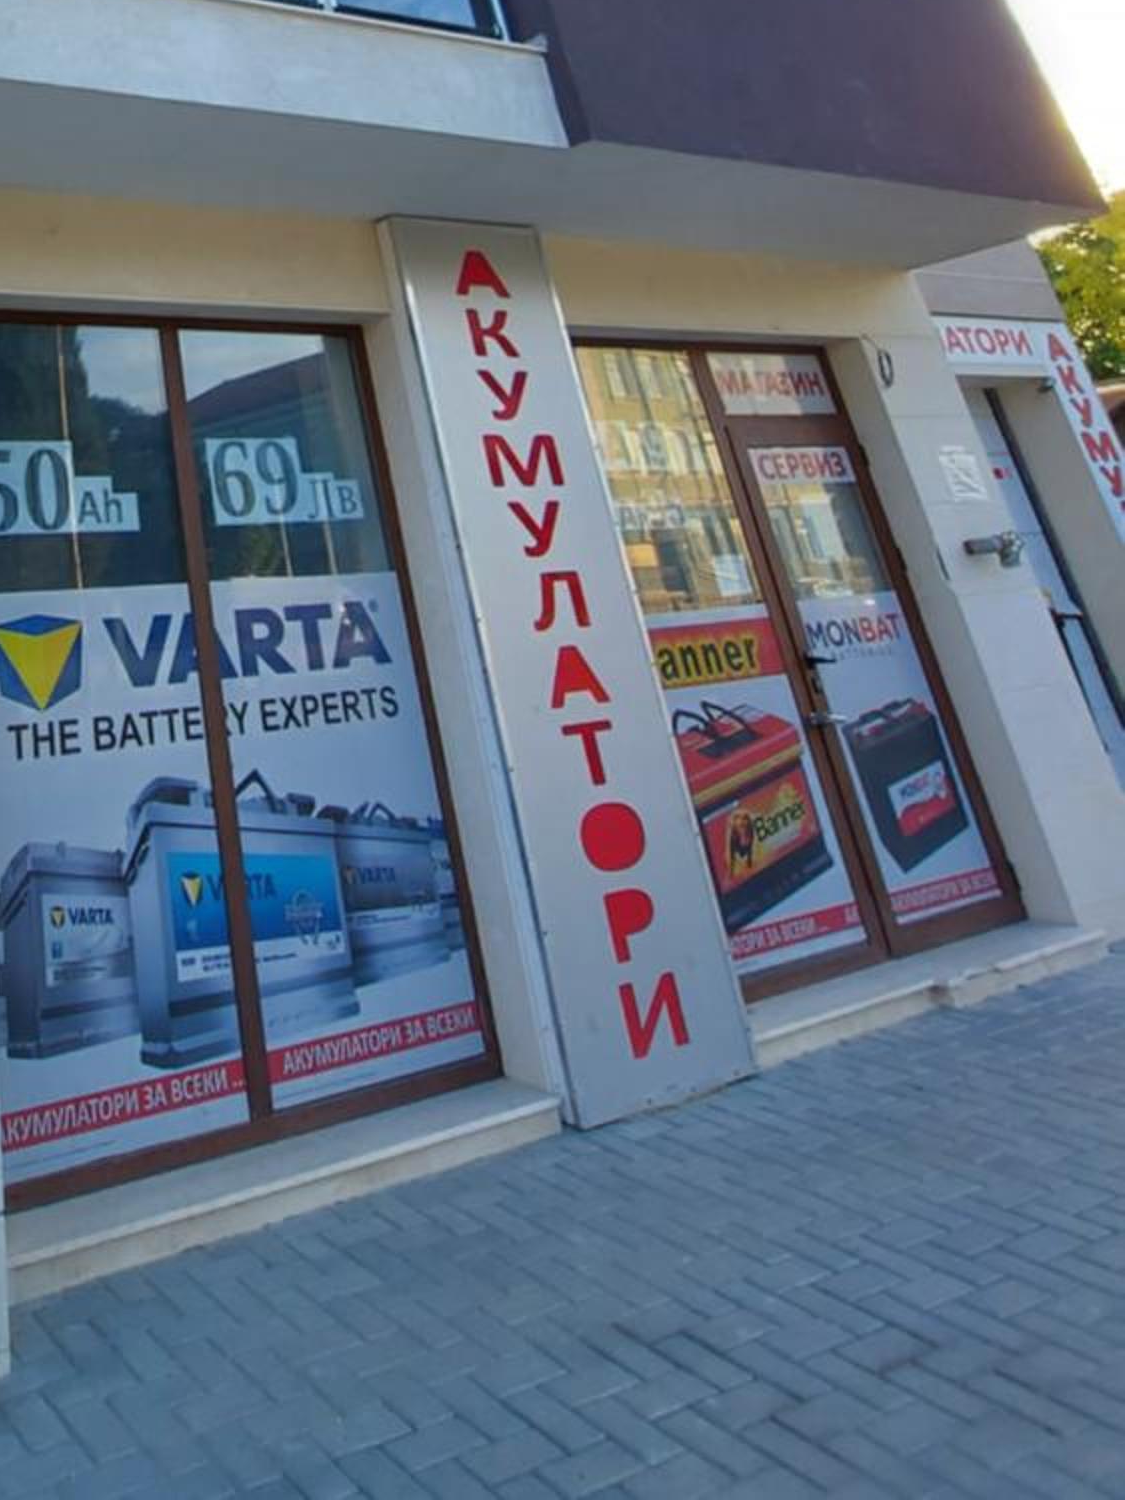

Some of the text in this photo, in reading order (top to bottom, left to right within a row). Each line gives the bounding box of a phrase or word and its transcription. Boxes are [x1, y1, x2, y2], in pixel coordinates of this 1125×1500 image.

[941, 326, 1034, 357] АТОРИ
[718, 370, 826, 397] МАГАЗИН
[1047, 331, 1125, 512] АКУМУ
[211, 440, 299, 518] 69
[758, 451, 847, 480] СЕРВИЗ
[805, 613, 901, 649] MONBAT
[455, 248, 690, 1059] АКУМУЛАТОРИ
[657, 638, 757, 681] anner
[8, 685, 400, 760] THE BATTEY EXPERTS
[68, 907, 114, 926] VARTA
[282, 1005, 474, 1075] АКУМУЛАТОРИ ЗА ВСЕКИ
[144, 1084, 167, 1111] ЗА
[171, 1071, 228, 1102] ВСЕКИ
